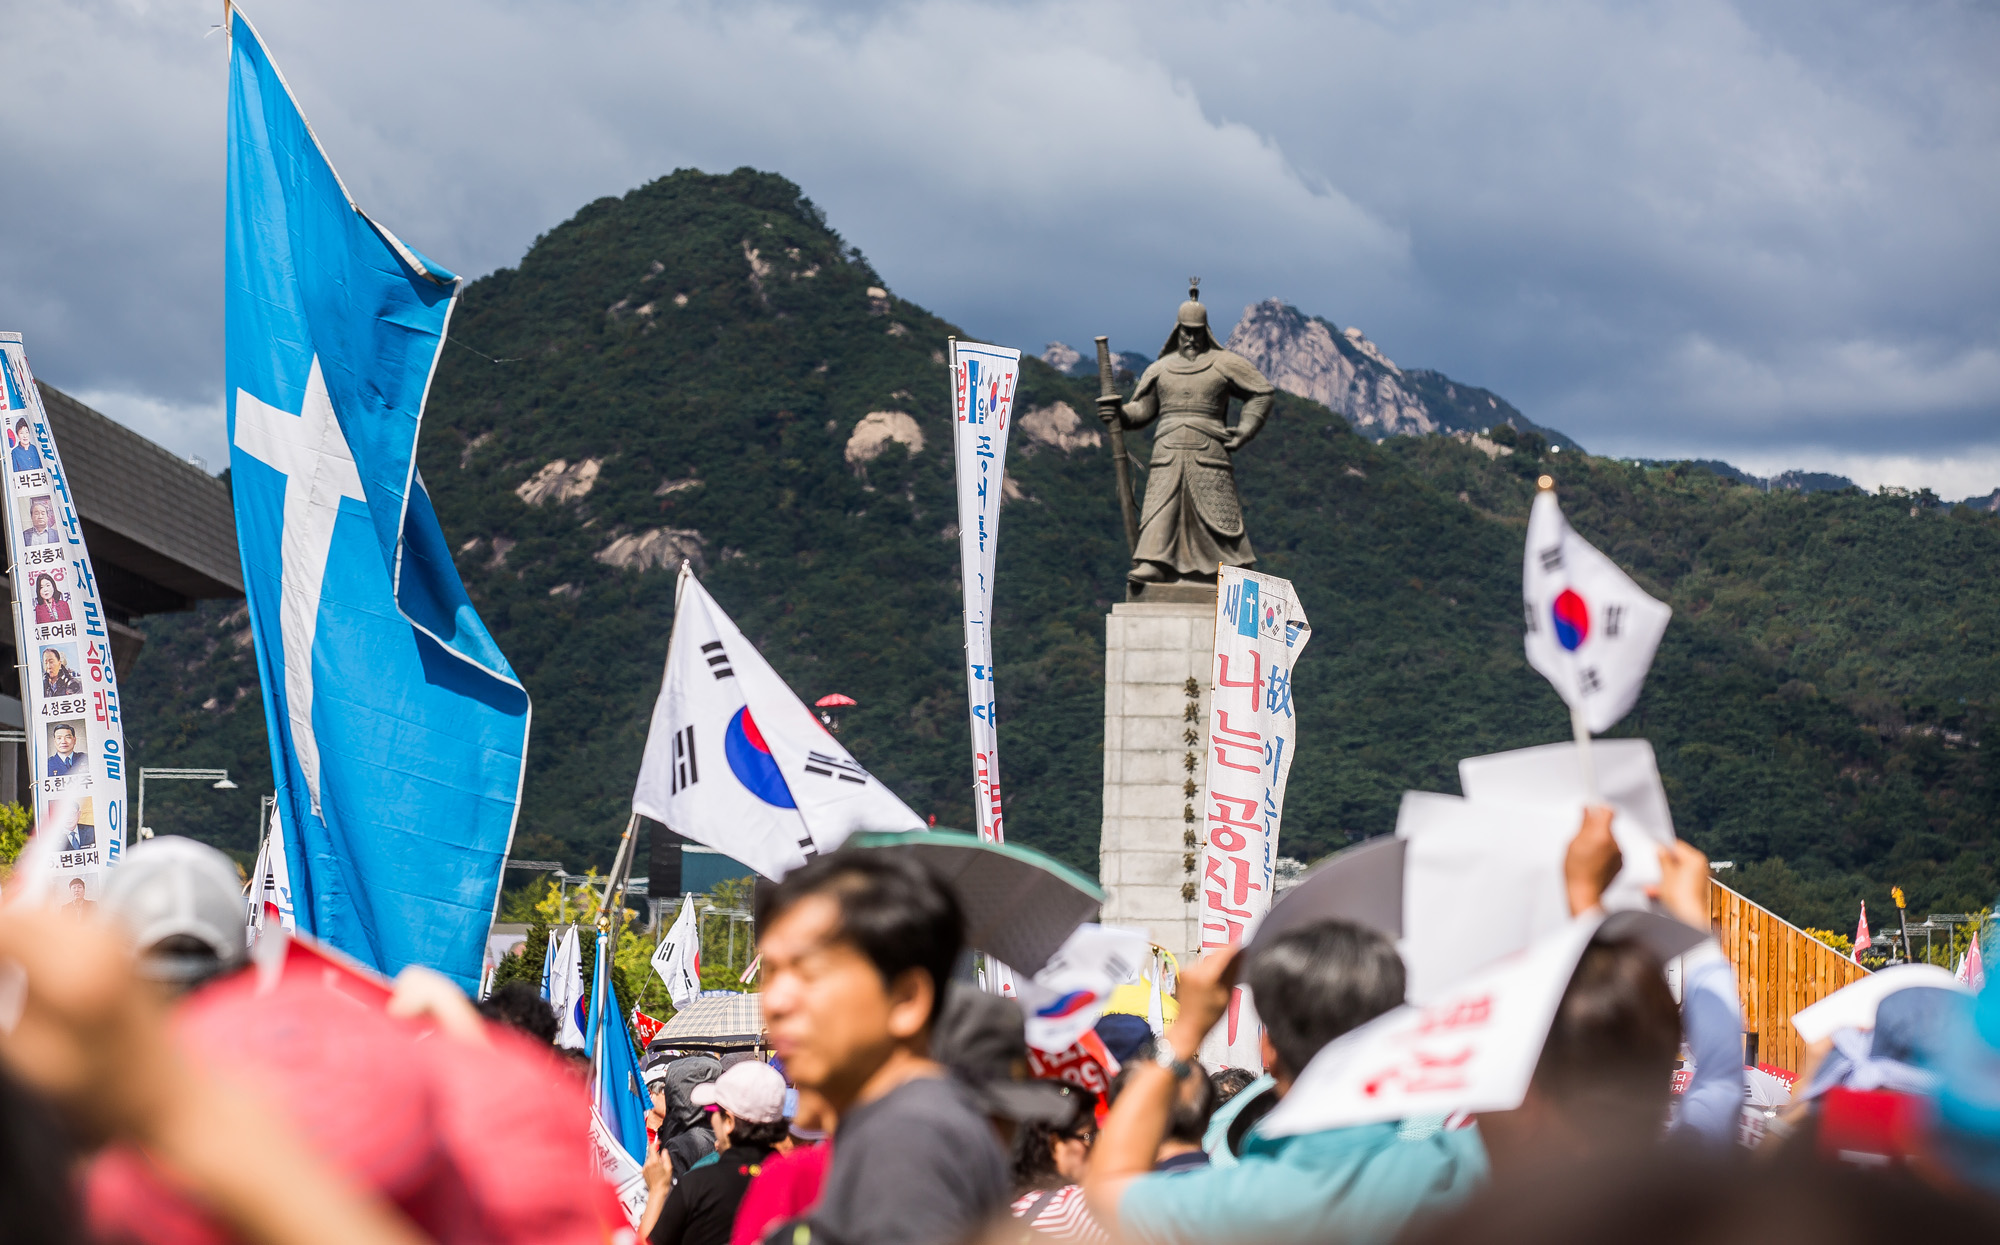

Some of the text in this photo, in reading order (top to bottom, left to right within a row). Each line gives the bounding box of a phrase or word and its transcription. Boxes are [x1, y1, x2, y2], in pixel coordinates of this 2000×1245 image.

[24, 546, 65, 566] 2.정충제
[35, 622, 77, 641] 3.류여해
[87, 640, 110, 730] 승리
[1266, 664, 1292, 718] 故
[41, 698, 87, 717] 4.정호양
[1212, 650, 1265, 774] 나는
